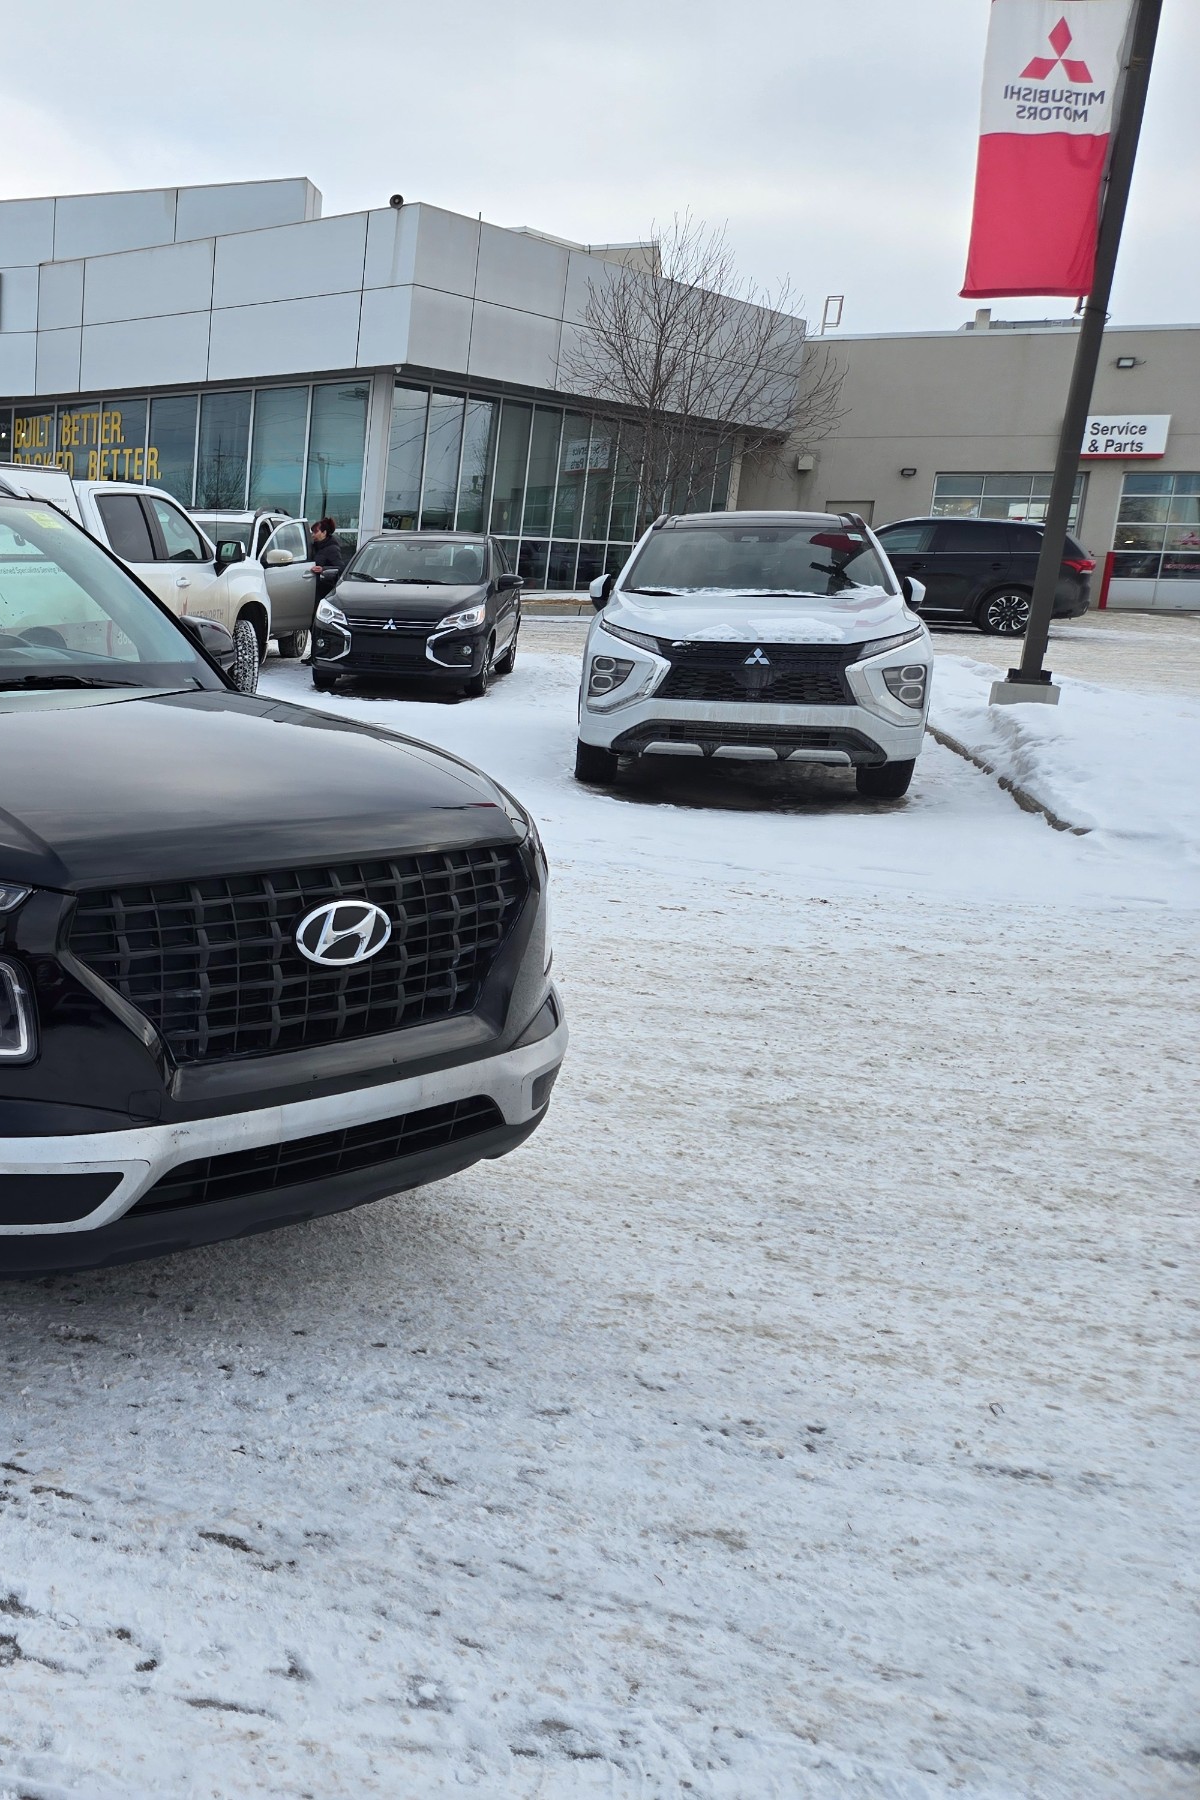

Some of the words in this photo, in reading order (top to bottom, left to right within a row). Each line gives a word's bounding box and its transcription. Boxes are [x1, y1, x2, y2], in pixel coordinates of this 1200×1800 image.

[14, 415, 51, 449] BUILT
[62, 411, 125, 446] BETTER.
[1090, 421, 1147, 436] Service
[1088, 439, 1099, 452] &
[1104, 439, 1144, 453] Parts
[88, 448, 162, 481] BETTER.
